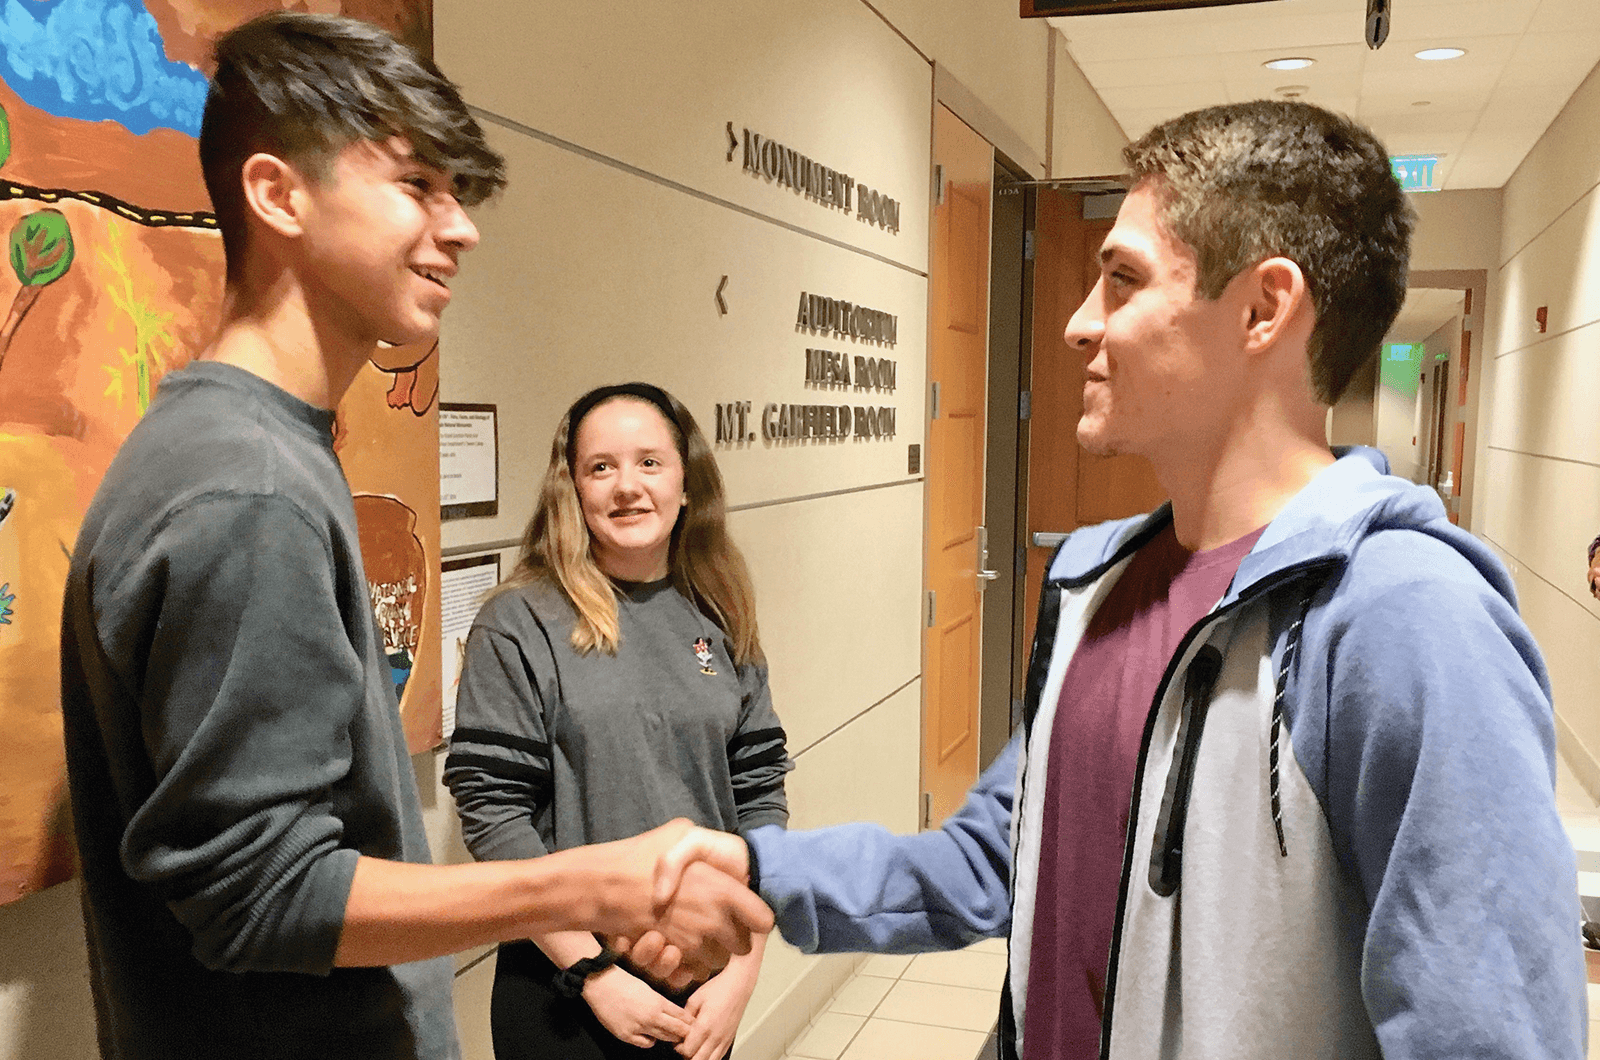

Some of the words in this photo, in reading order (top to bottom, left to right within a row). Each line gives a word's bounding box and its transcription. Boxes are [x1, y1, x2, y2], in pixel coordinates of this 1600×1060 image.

[743, 128, 854, 213] MONUMENT
[857, 183, 900, 234] ROOM
[797, 291, 897, 345] AUDITORIUM
[805, 348, 851, 388] MESA
[854, 355, 897, 392] ROOM
[715, 400, 756, 445] MT.
[761, 402, 851, 443] GARFIELD
[853, 405, 896, 441] ROOM
